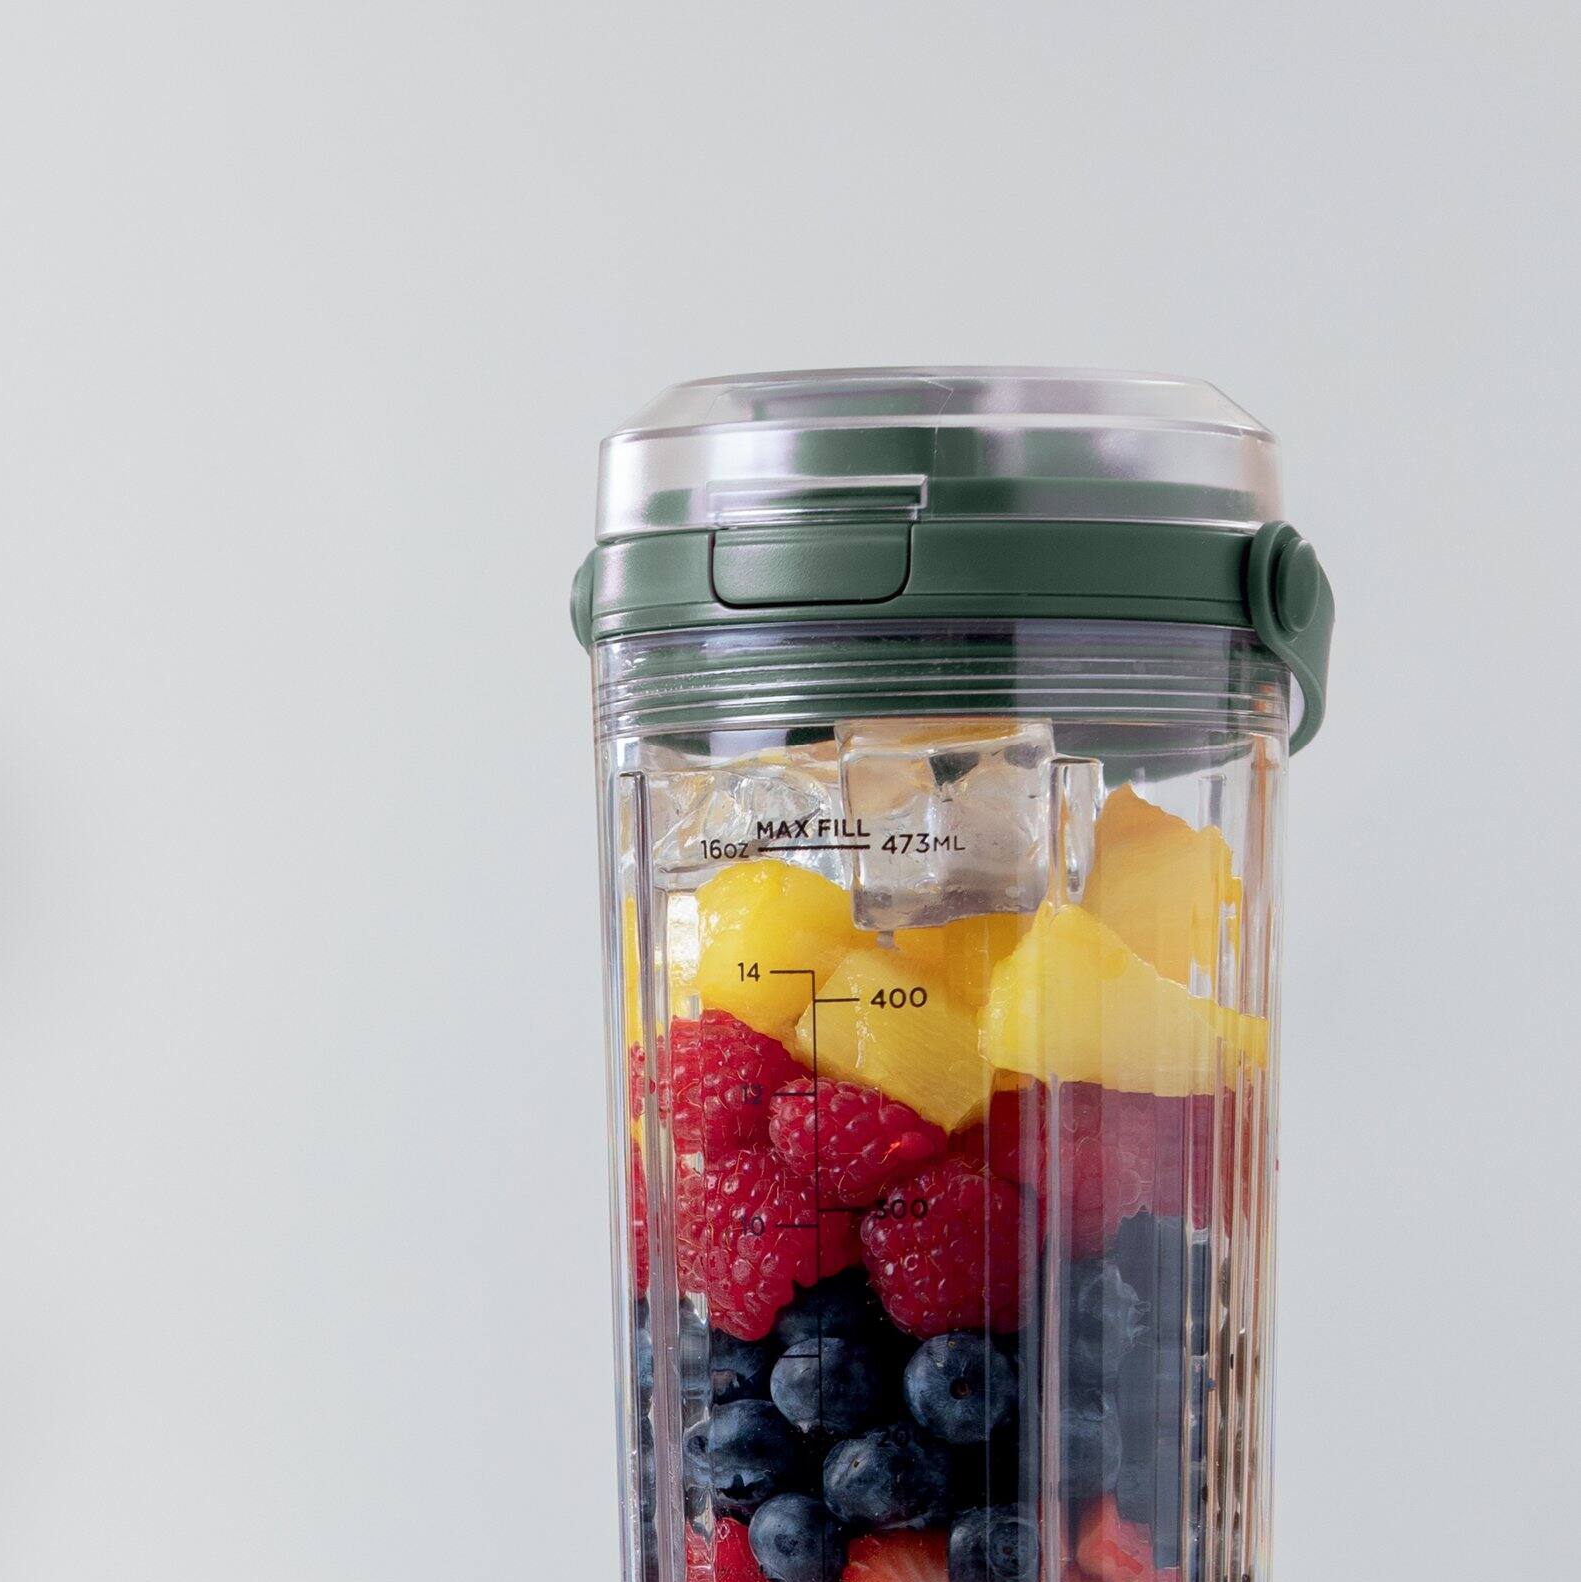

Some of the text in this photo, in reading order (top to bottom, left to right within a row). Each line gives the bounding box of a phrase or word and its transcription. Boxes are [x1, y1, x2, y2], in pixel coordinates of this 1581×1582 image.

[756, 819, 871, 840] MAX FILL
[881, 832, 967, 855] 473ML
[737, 962, 761, 982] 14
[870, 986, 928, 1009] 400
[742, 1082, 763, 1105] 12
[740, 1214, 765, 1237] 10
